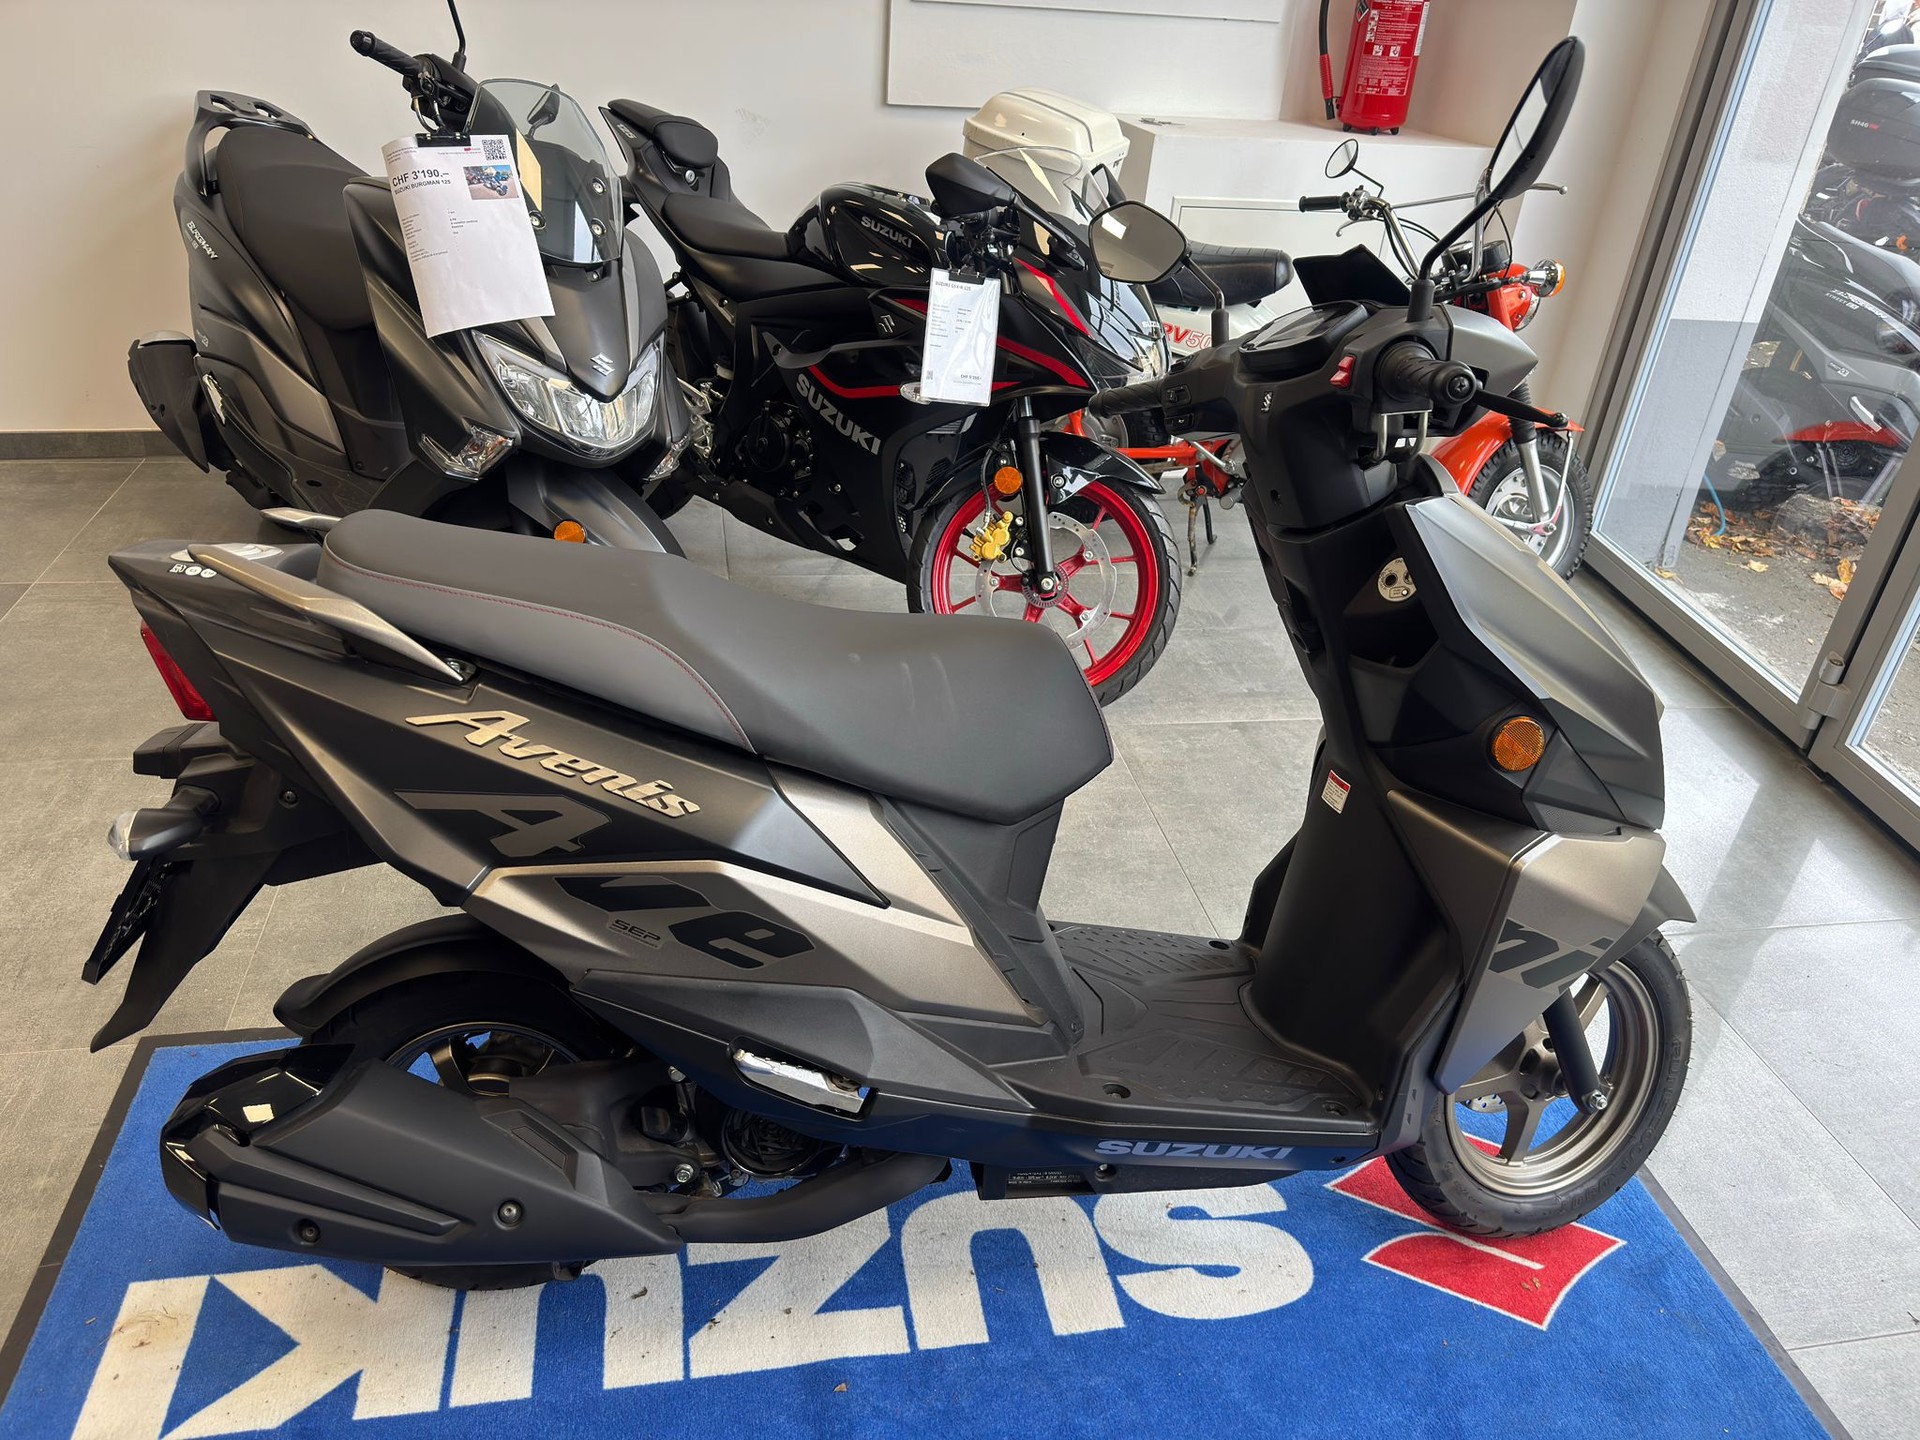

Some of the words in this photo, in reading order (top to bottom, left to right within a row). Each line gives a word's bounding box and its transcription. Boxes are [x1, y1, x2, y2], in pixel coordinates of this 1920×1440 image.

[392, 172, 409, 187] CHF
[411, 180, 441, 189] BURGMAN
[860, 216, 913, 248] SUZUKI
[796, 373, 881, 456] SUZUKI
[405, 710, 701, 818] Avenis
[611, 919, 661, 941] SEP
[1094, 1139, 1296, 1161] SUZUKI
